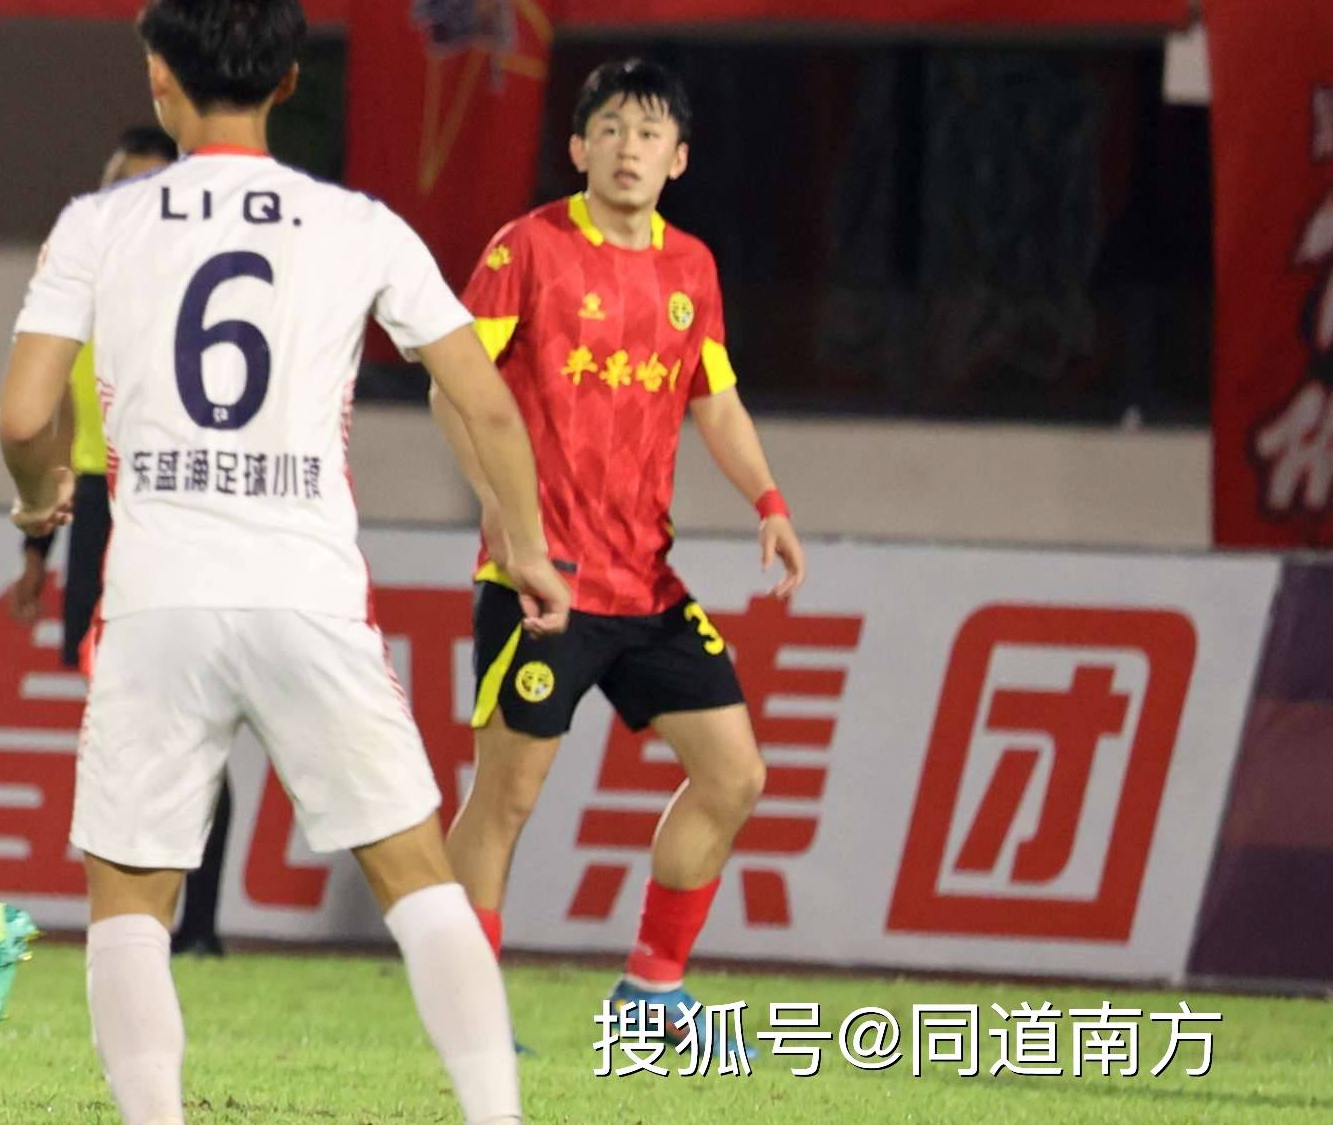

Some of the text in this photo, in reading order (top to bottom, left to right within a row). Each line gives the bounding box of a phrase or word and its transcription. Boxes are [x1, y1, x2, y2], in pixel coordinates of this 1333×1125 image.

[160, 187, 303, 226] LI Q.
[174, 250, 274, 431] 6
